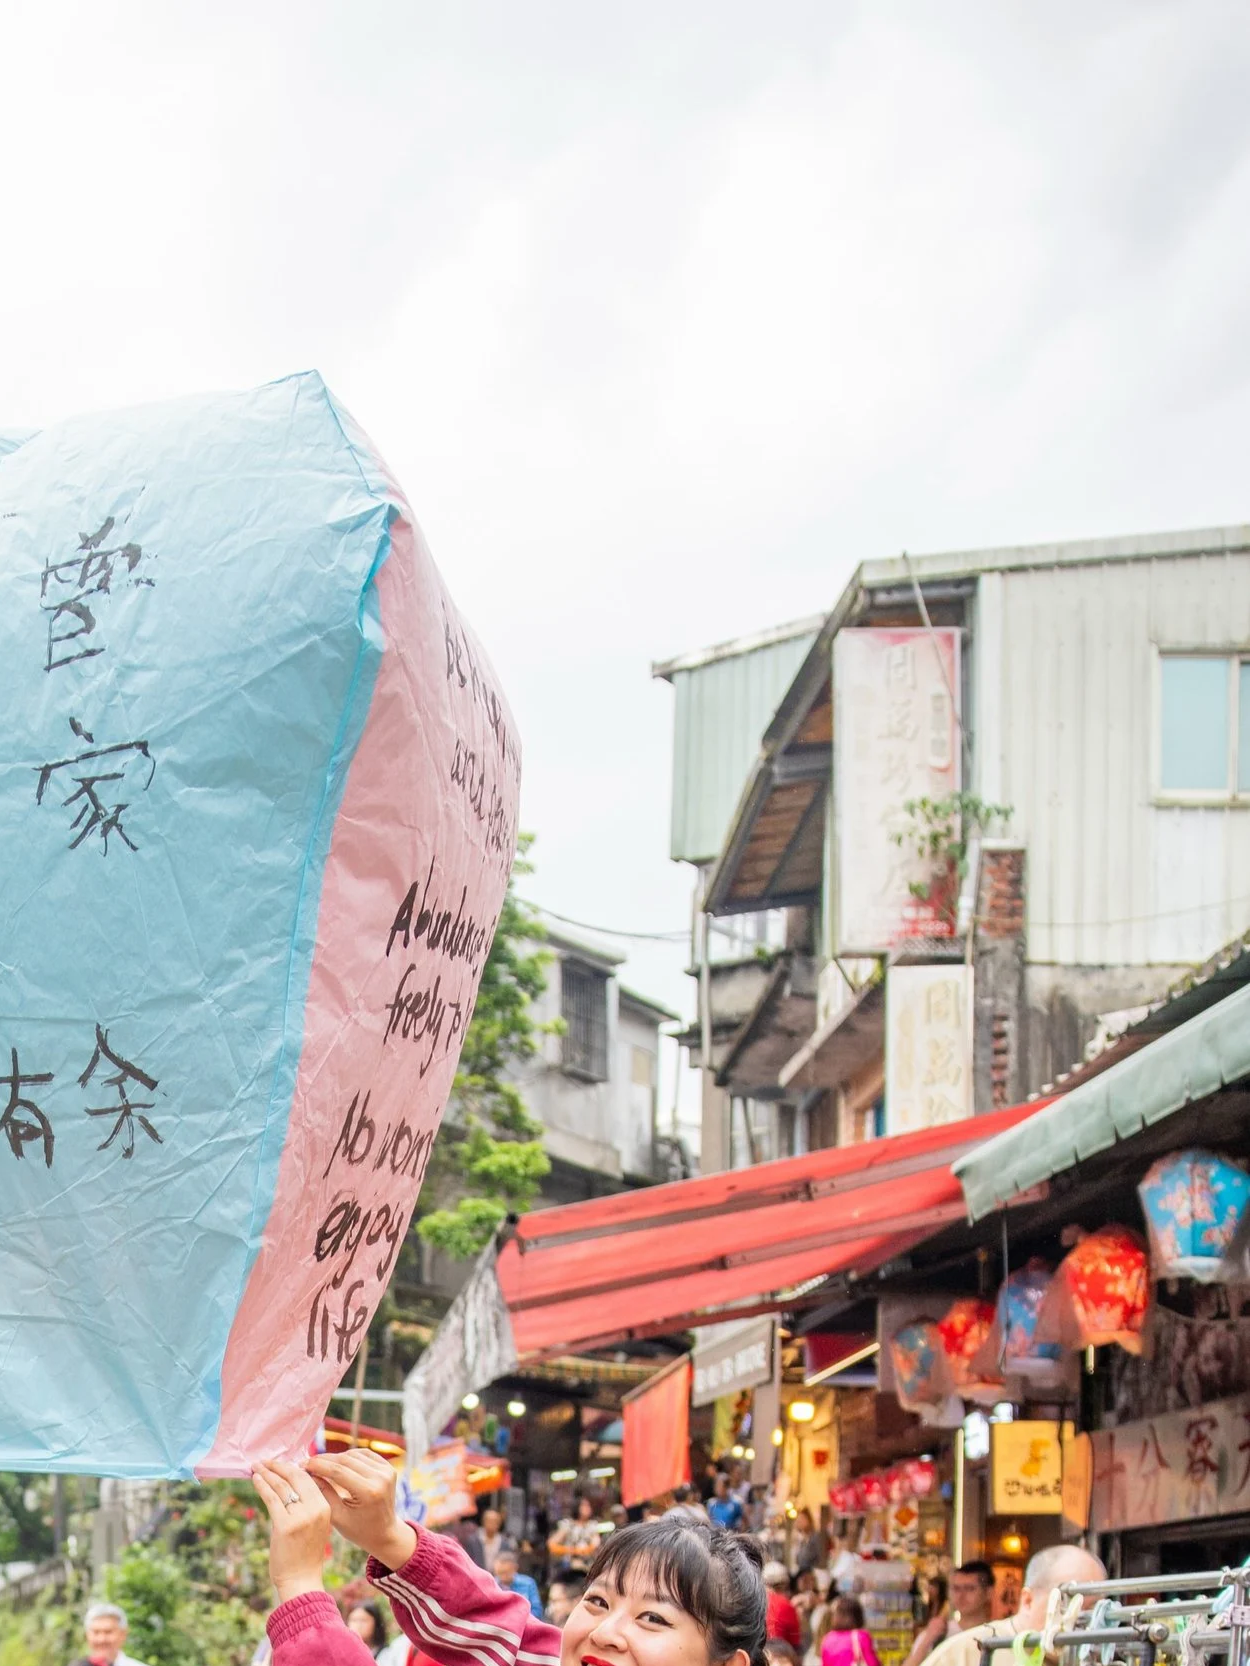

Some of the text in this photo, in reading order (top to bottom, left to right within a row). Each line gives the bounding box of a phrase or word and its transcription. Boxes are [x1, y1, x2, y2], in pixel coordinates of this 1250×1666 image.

[383, 962, 447, 1080] freely
[322, 1089, 376, 1180] No
[313, 1196, 405, 1289] enjoy
[306, 1279, 369, 1364] life
[1092, 1412, 1250, 1526] 十分客
